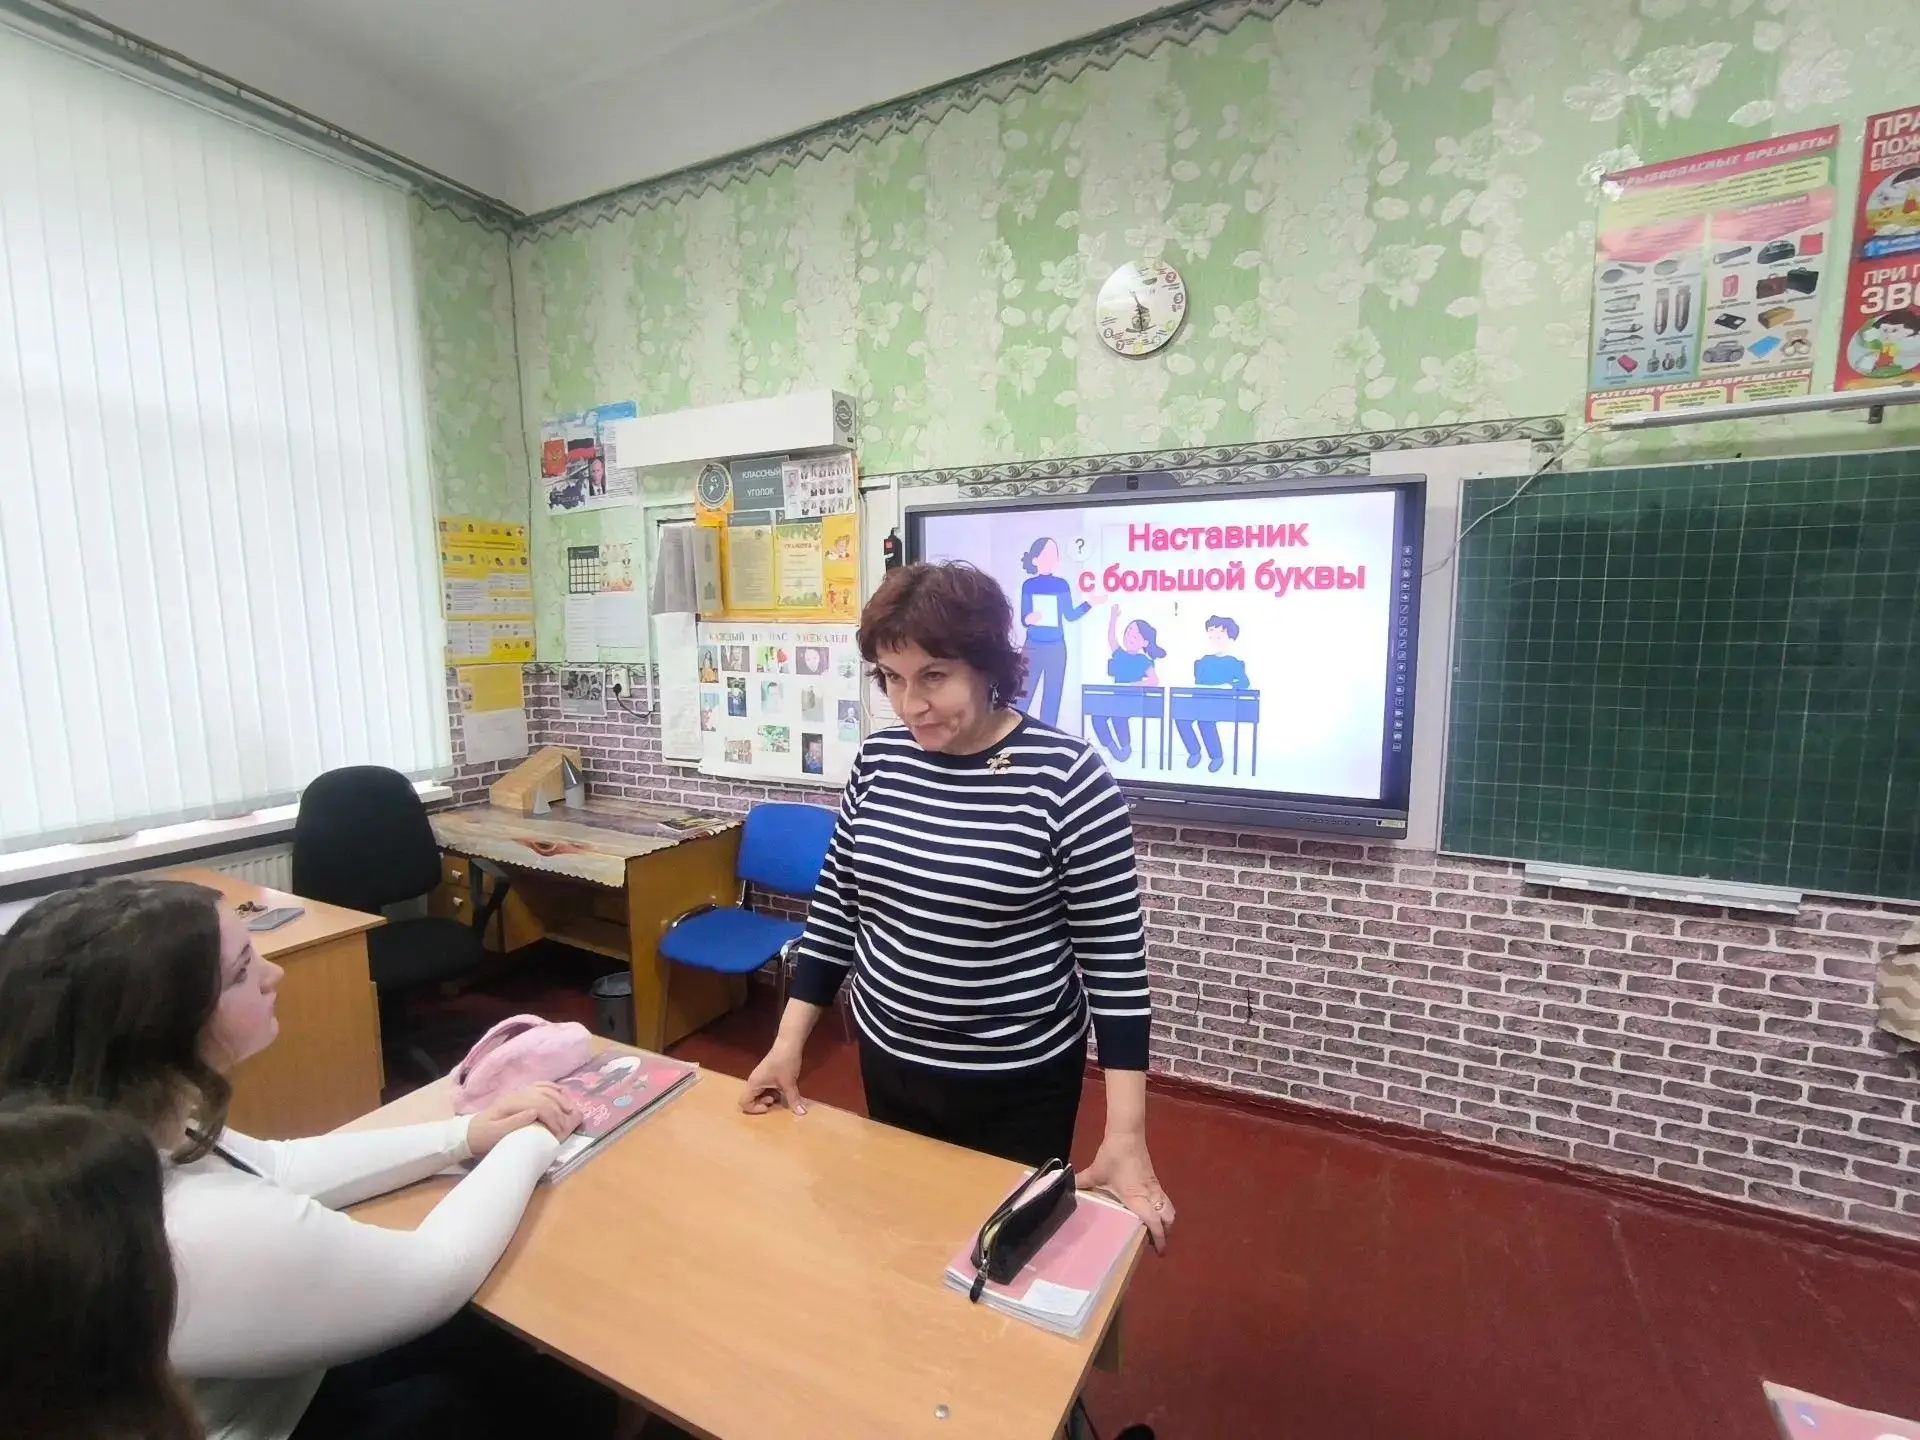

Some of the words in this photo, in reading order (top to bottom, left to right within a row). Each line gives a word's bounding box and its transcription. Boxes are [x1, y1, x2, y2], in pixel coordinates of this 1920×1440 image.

[1863, 266, 1907, 286] ПРИ
[1590, 381, 1702, 399] КАТЕГОРИЧЕСКИ
[1703, 368, 1812, 387] ЗАПРЕЩАЕТСЯ
[1128, 523, 1309, 551] Наставник
[1078, 570, 1095, 592] с
[1102, 561, 1245, 592] большой
[1254, 558, 1365, 597] буквы
